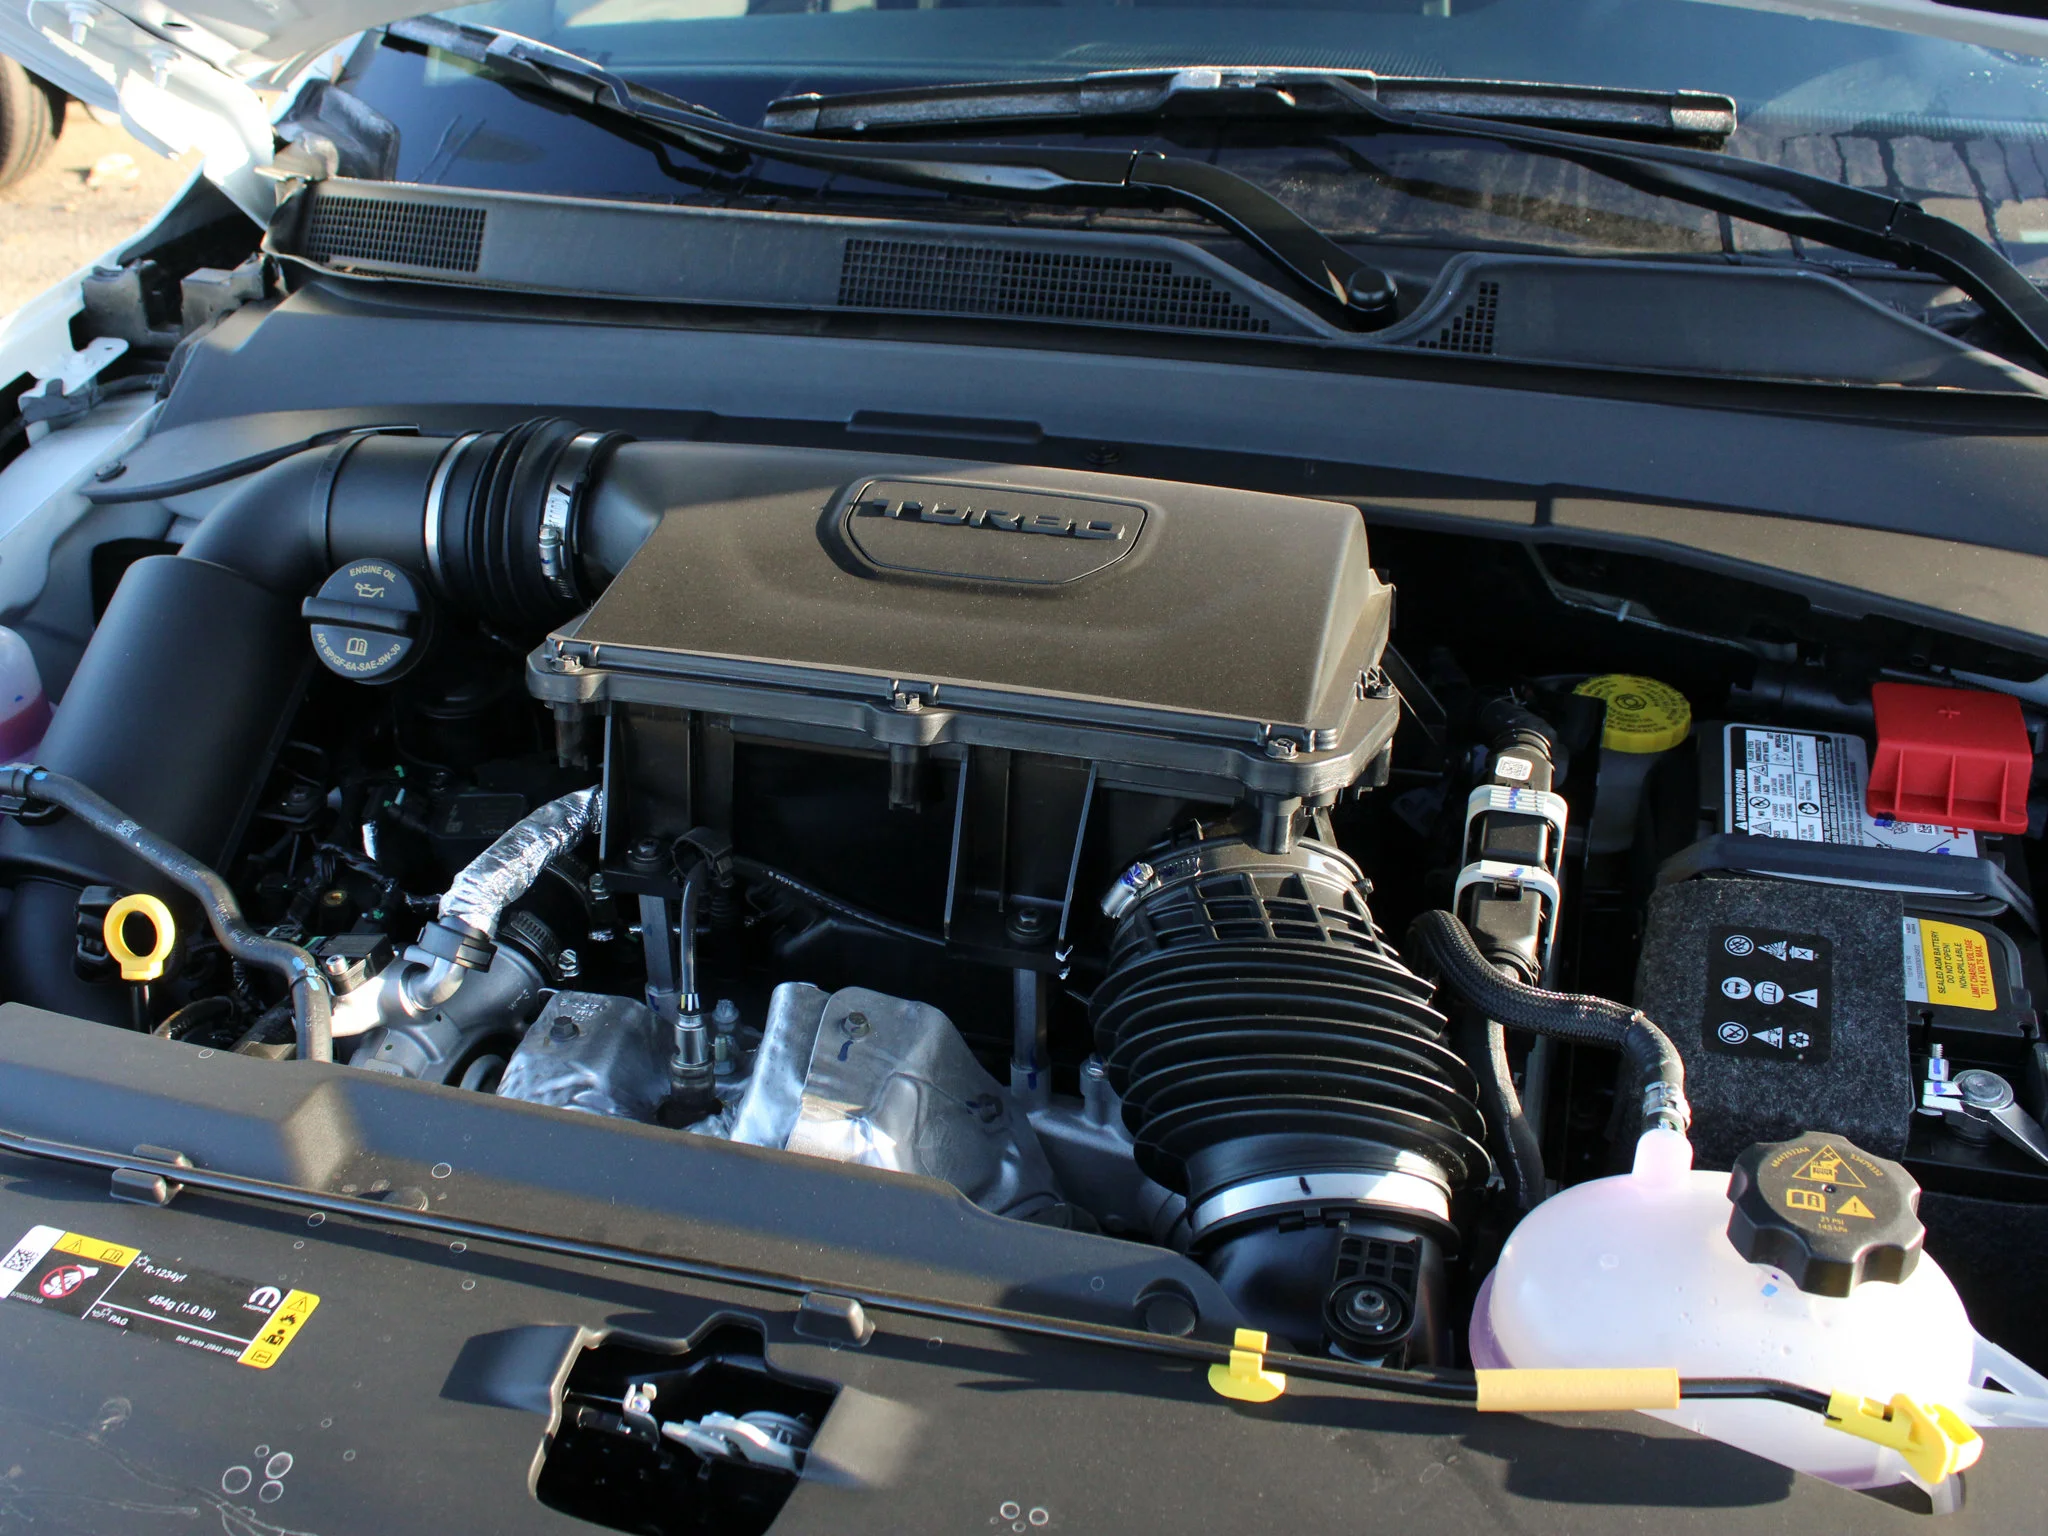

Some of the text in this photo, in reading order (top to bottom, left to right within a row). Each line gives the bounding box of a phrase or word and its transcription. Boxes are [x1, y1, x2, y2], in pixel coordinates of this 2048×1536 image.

[860, 497, 1126, 541] TURBO
[349, 565, 397, 582] ENGINE OIL
[317, 633, 325, 648] API
[1736, 769, 1746, 821] DANGER/POISON
[1931, 931, 1946, 994] SEALED AGM BATTERY
[1945, 962, 1953, 974] NOT
[1954, 943, 1967, 988] NON-SPILLABLE
[1964, 939, 1980, 998] LIMIT CHARGE VOLTAGE
[1977, 958, 1986, 974] VOLTS
[1947, 975, 1955, 984] DO
[1981, 986, 1989, 994] TO
[143, 1264, 188, 1283] R-1234yf
[148, 1294, 217, 1322] 454g (1.0 lb)
[108, 1313, 129, 1326] PAG
